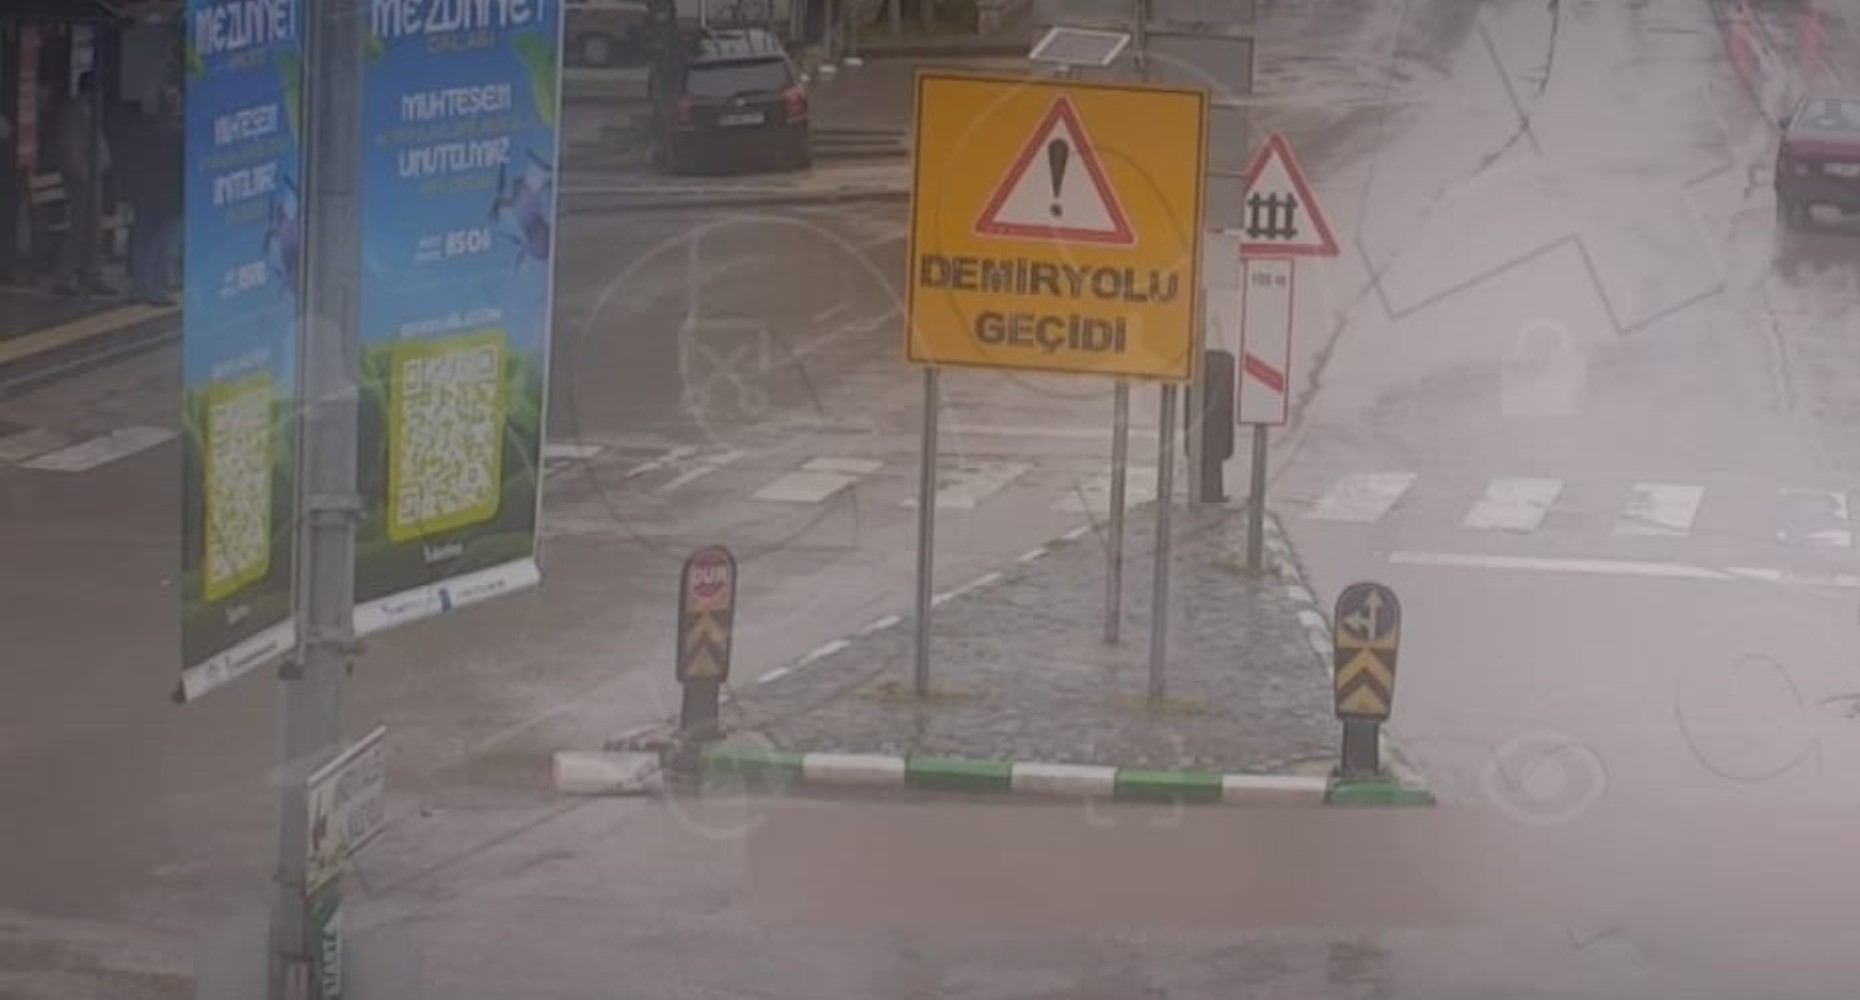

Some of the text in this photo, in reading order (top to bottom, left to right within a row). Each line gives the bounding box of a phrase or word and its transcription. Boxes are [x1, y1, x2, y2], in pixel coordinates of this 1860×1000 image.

[920, 252, 1180, 303] DEMİRYOLU
[975, 311, 1127, 354] GEÇİDİ
[691, 565, 728, 585] DUR
